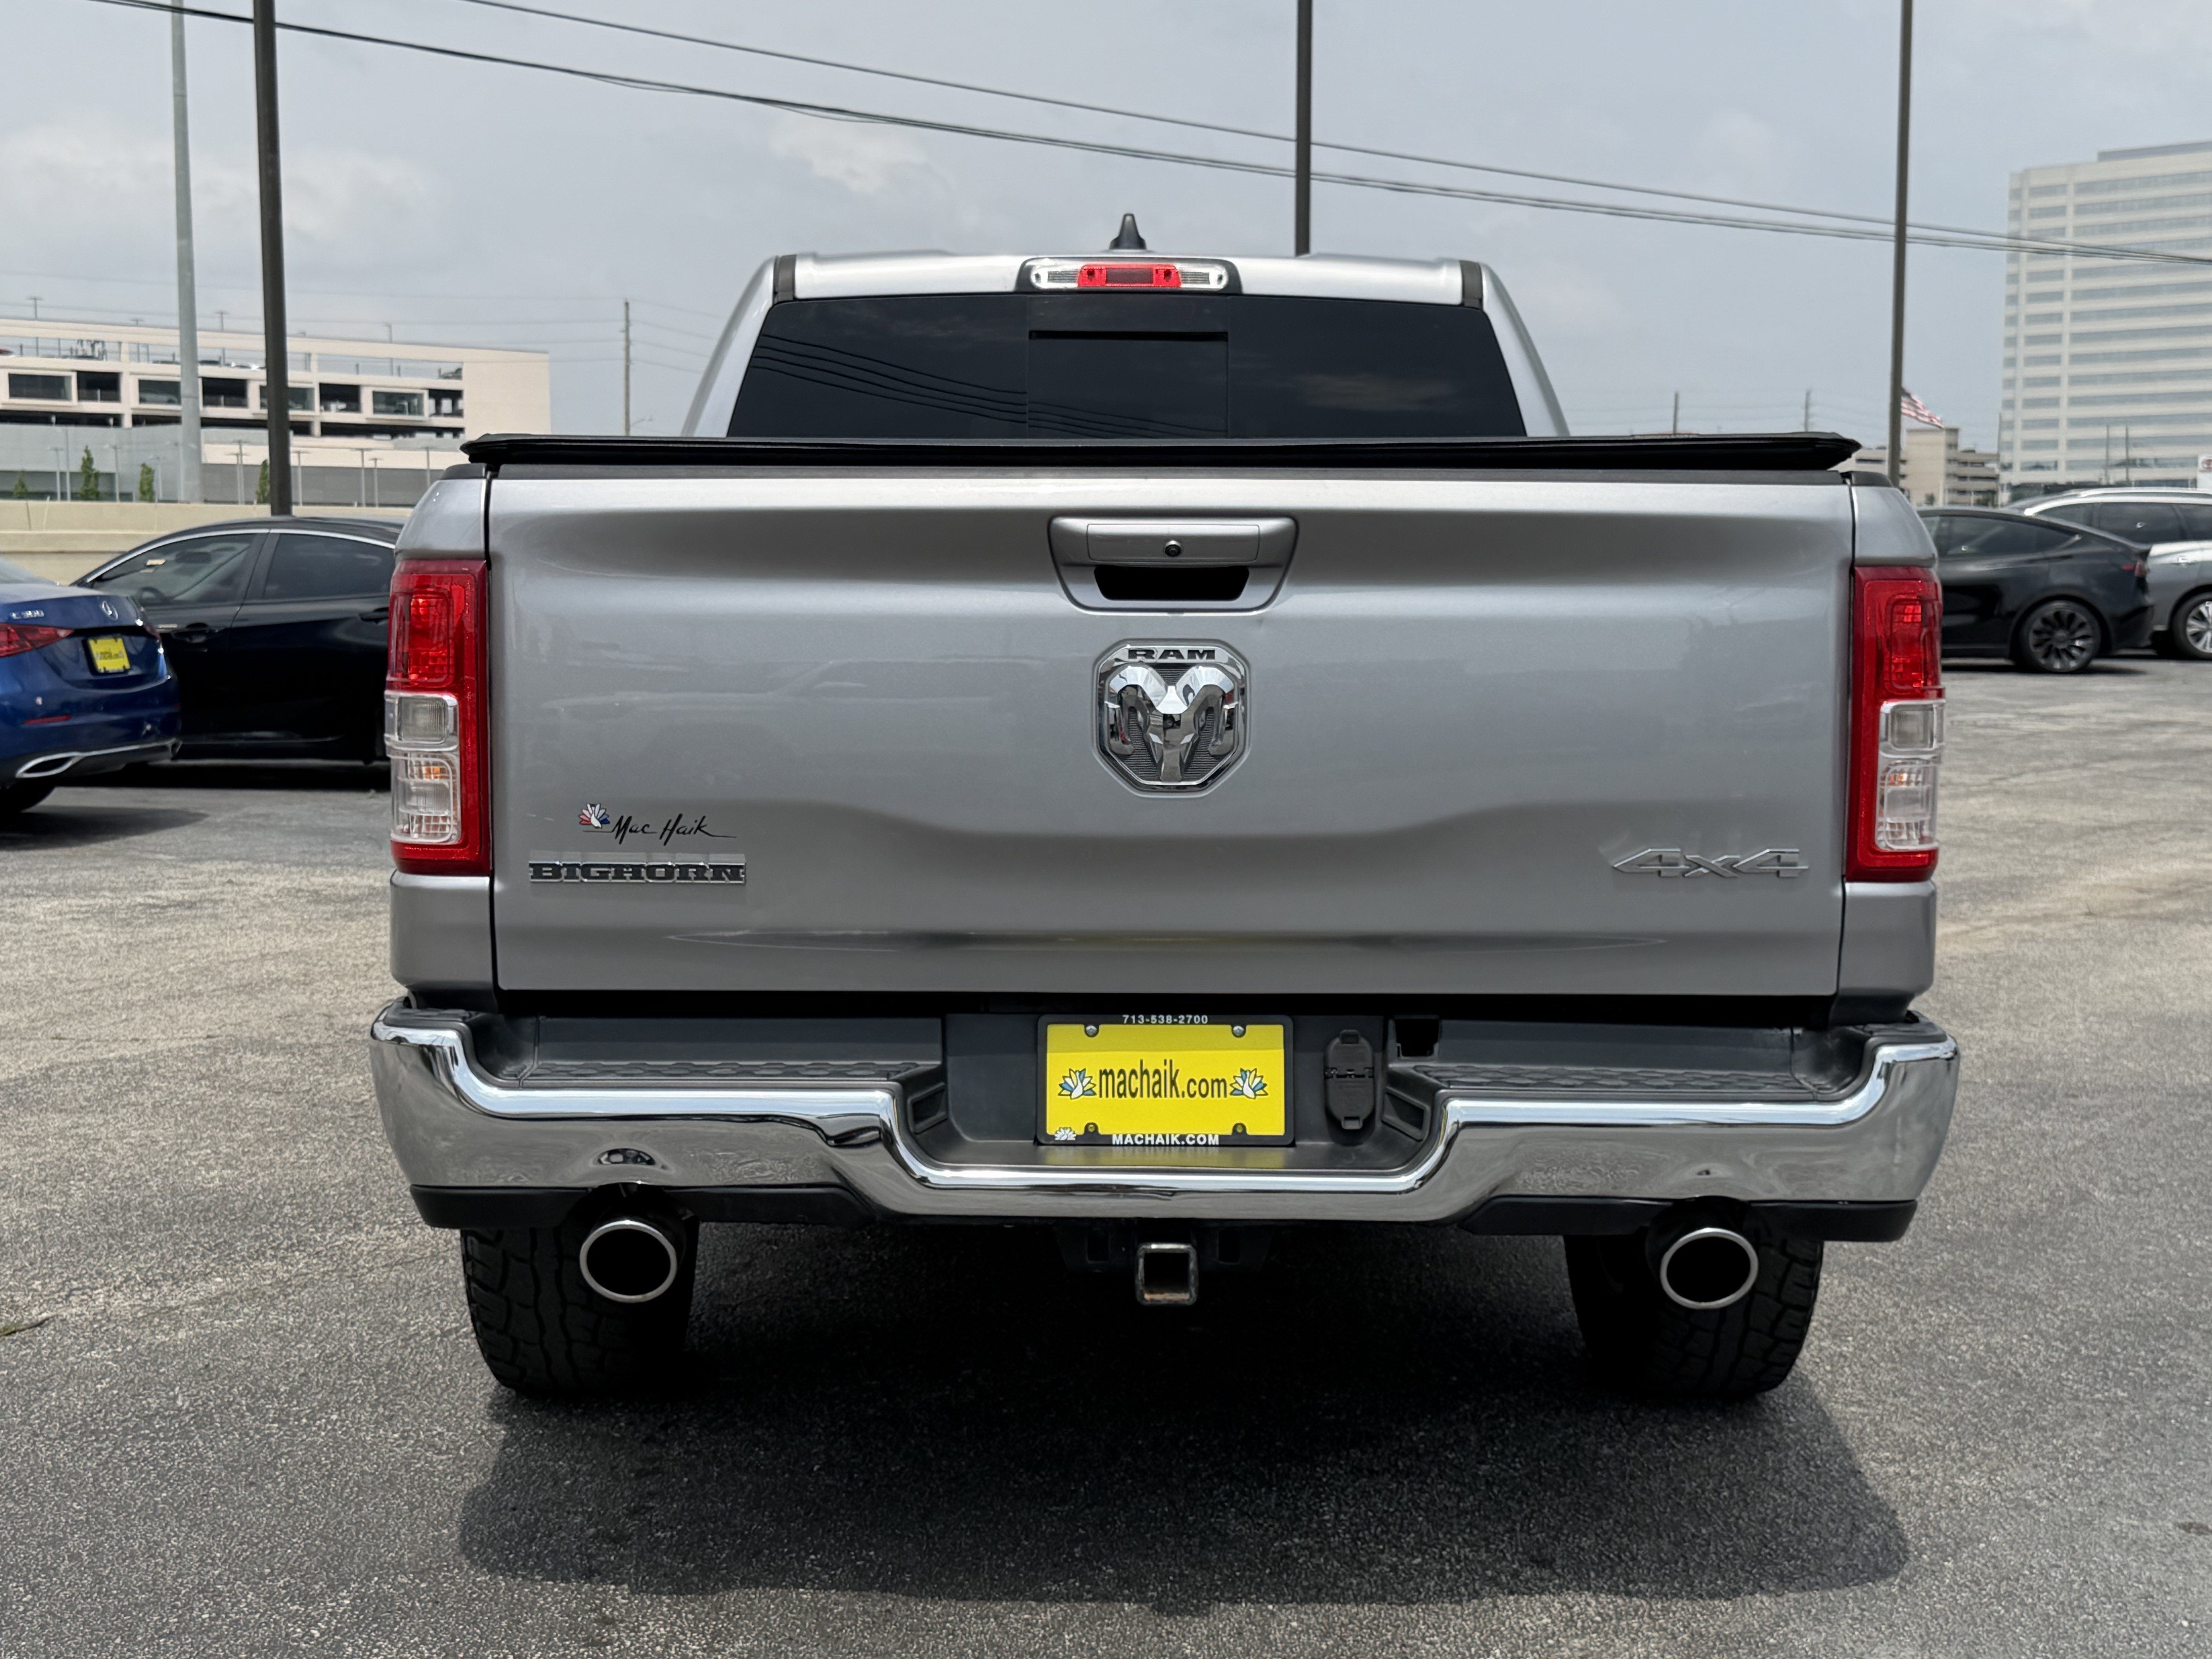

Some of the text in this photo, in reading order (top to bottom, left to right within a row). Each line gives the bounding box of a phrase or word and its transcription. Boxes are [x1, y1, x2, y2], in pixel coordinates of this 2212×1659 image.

[1128, 649, 1216, 660] RAM
[598, 814, 732, 846] Mac Haik
[528, 860, 746, 883] BIGHORN
[1122, 1014, 1208, 1024] 713-538-2700
[1098, 1059, 1228, 1099] machaik.com
[1111, 1134, 1219, 1146] MACHAIK.COM
